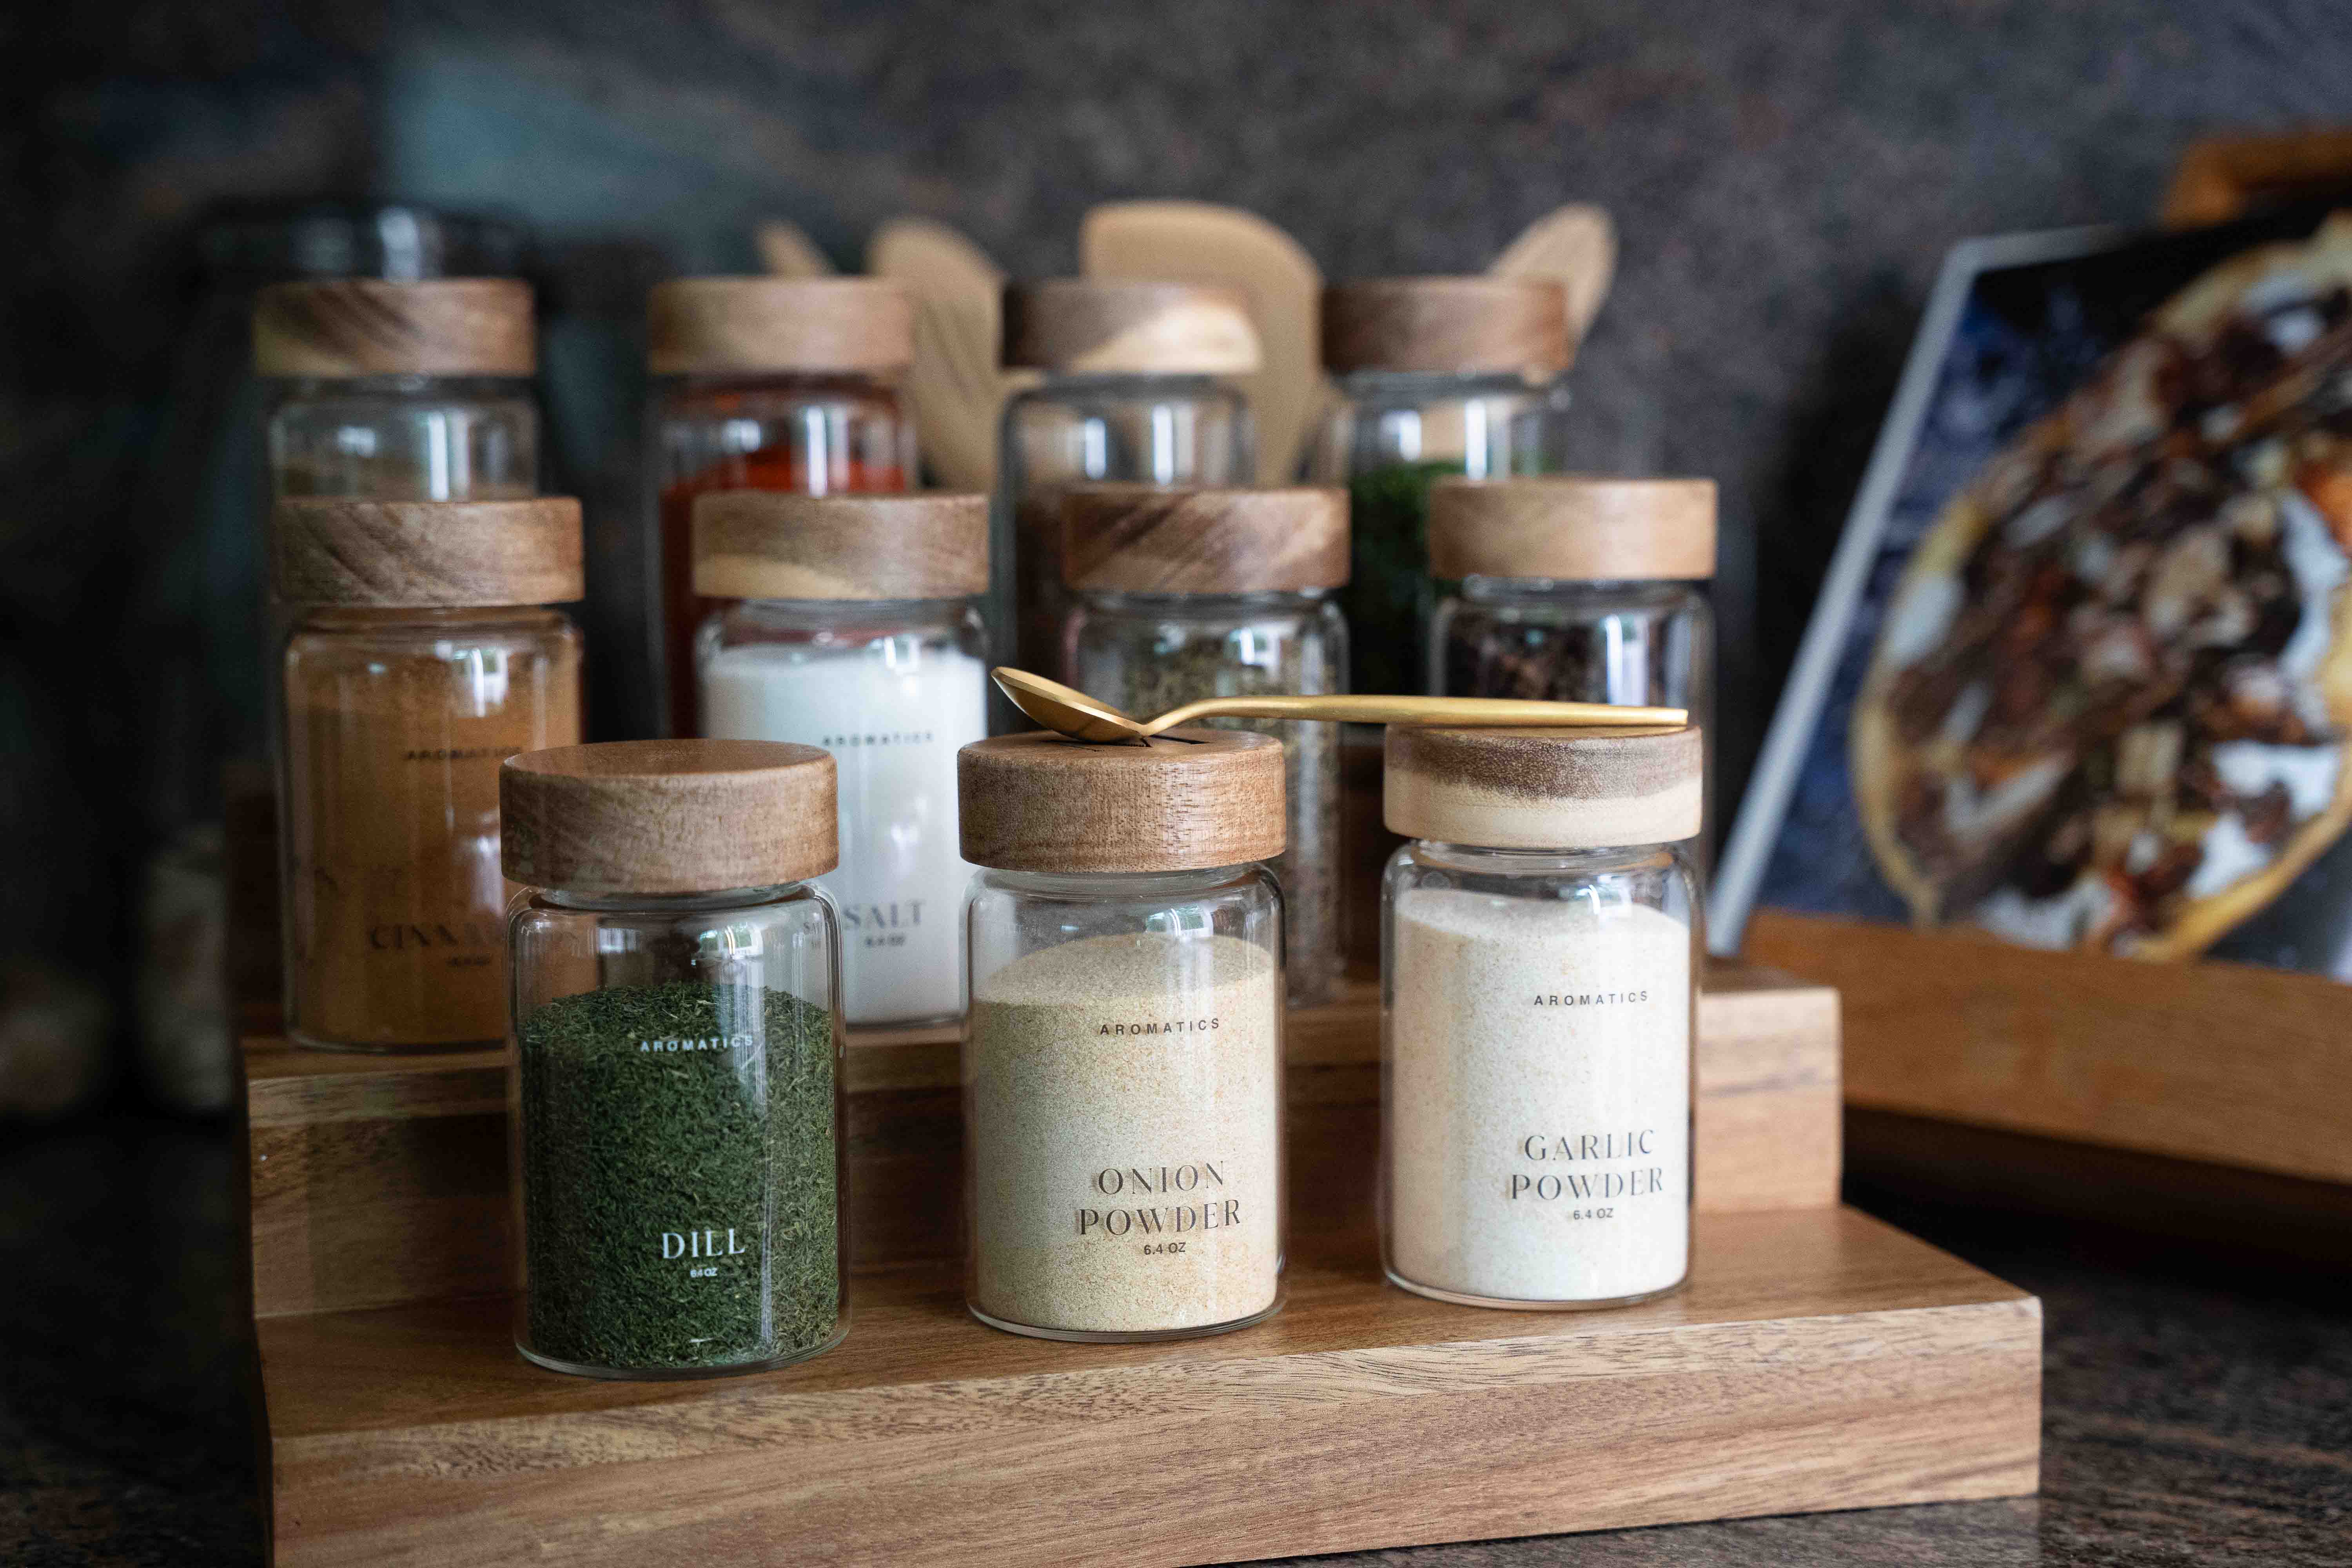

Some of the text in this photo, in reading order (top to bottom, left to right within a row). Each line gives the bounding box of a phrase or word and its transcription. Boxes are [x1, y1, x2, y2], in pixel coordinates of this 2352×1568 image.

[842, 900, 926, 929] SALT
[1534, 991, 1647, 1006] AROMATICS
[1100, 1018, 1219, 1035] AROMATICS
[640, 1034, 753, 1052] AROMATICS
[1525, 1129, 1653, 1161] GARLIC
[1098, 1161, 1223, 1194] ONION
[1512, 1167, 1663, 1200] POWDER
[1080, 1200, 1240, 1235] POWDER
[1573, 1208, 1614, 1220] 6.4 OZ
[662, 1229, 746, 1259] DILL
[1143, 1242, 1186, 1255] 6.4 OZ
